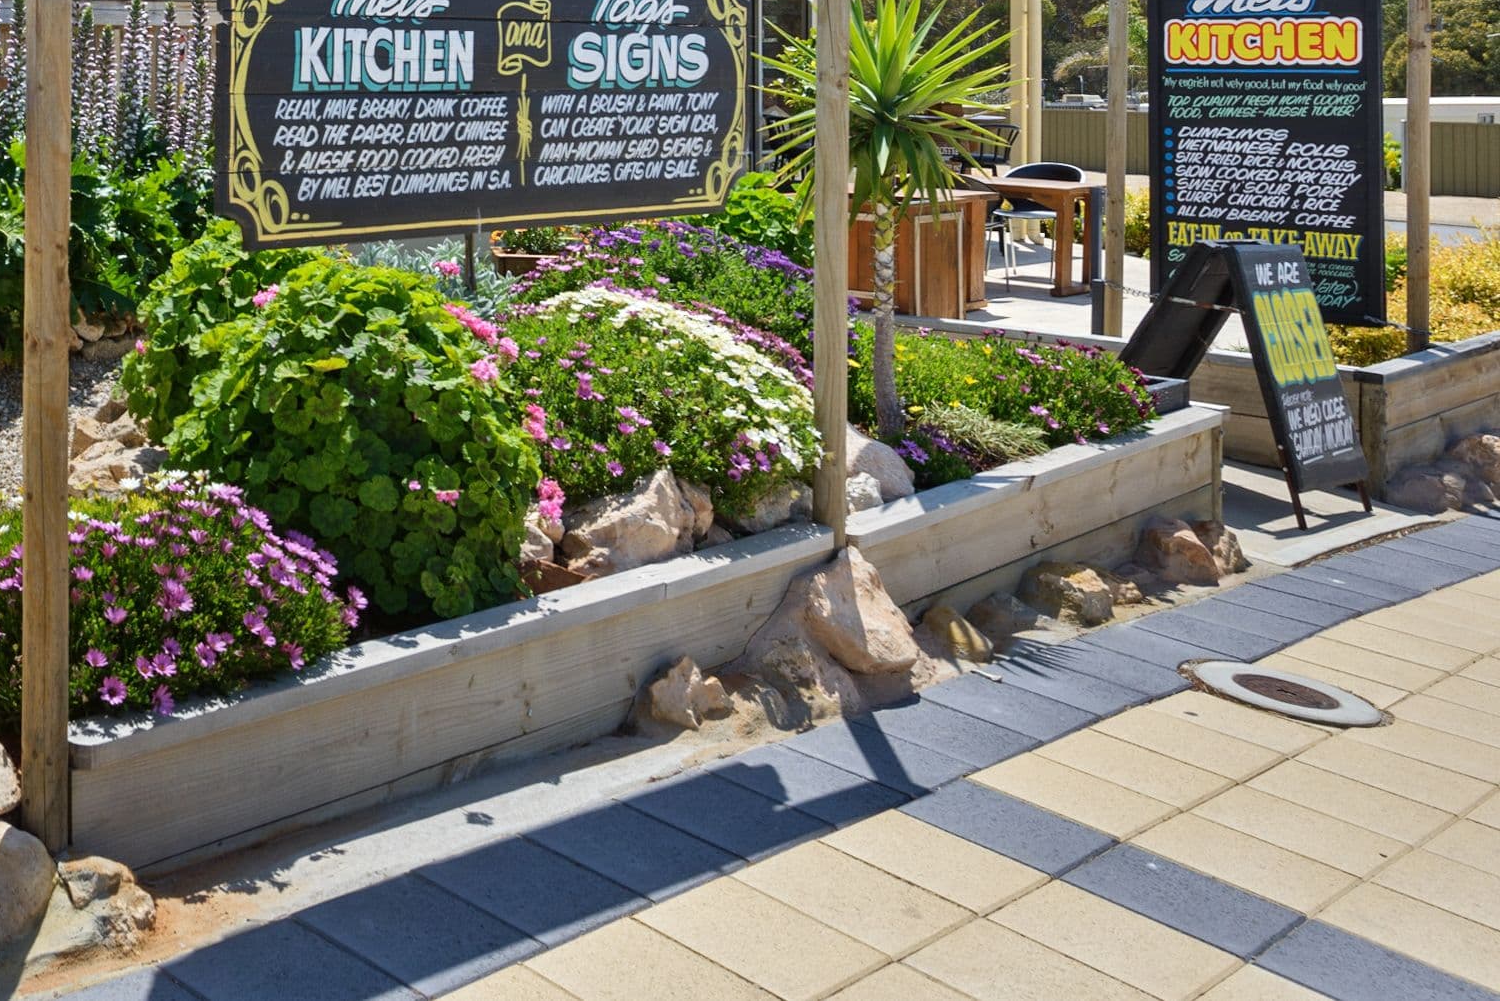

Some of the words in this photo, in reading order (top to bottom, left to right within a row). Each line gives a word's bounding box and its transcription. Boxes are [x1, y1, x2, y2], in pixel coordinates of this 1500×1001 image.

[505, 14, 546, 49] and
[1165, 18, 1362, 65] KITCHEN
[293, 27, 474, 91] KITCHEN
[567, 32, 709, 89] SIGNS
[1210, 77, 1224, 88] not
[1245, 79, 1270, 90] good,
[1271, 79, 1286, 89] but
[1288, 81, 1301, 91] my
[1303, 79, 1323, 90] food
[274, 98, 321, 121] RELAX,
[322, 98, 358, 120] HAVE
[358, 97, 412, 120] BREAKY,
[414, 98, 458, 118] DRINK
[459, 96, 508, 119] COFFEE,
[540, 94, 575, 114] WITH
[576, 95, 588, 114] A
[589, 94, 637, 114] BRUSH
[636, 92, 647, 112] &
[647, 93, 683, 113] PAINT,
[685, 92, 719, 111] TONY
[1167, 95, 1191, 107] TOP
[1192, 95, 1243, 107] QUALITY
[1242, 95, 1279, 106] FRESH
[1278, 95, 1314, 105] HOME
[1313, 94, 1360, 105] COOKED
[1169, 107, 1203, 119] FOOD,
[273, 125, 319, 147] READ
[321, 124, 350, 146] THE
[350, 123, 405, 145] PAPER,
[406, 122, 454, 143] ENJOY
[454, 120, 509, 141] CHINESE
[540, 118, 570, 138] CAN
[571, 116, 615, 137] CREATE
[657, 115, 690, 135] SIGN
[690, 114, 719, 134] IDEA,
[1177, 126, 1290, 141] DUMPLINGS
[280, 151, 296, 174] &
[296, 150, 356, 174] AUSSIE
[354, 148, 399, 172] FOOD
[399, 147, 459, 170] COOKED
[458, 145, 506, 167] FRESH
[625, 139, 660, 160] SHED
[660, 137, 703, 158] SIGNS
[703, 140, 712, 156] &
[1178, 138, 1284, 155] VIETNAMESE
[1285, 142, 1350, 158] ROLLS
[534, 162, 612, 186] CARICATURES,
[613, 160, 645, 181] GIFTS
[645, 160, 662, 178] ON
[663, 159, 700, 179] SALE.
[1174, 152, 1205, 164] STIR
[1204, 153, 1242, 166] FRIED
[1243, 155, 1276, 168] RICE
[1276, 159, 1285, 168] &
[1286, 158, 1358, 172] NOODLES
[298, 177, 321, 202] BY
[352, 174, 391, 198] BEST
[391, 171, 469, 197] DUMPLINGS
[470, 171, 487, 191] IN
[1175, 164, 1215, 179] SLOW
[1215, 166, 1279, 182] COOKED
[1279, 170, 1319, 185] PORK
[1318, 172, 1362, 188] BELLY
[1176, 178, 1230, 192] SWEET
[1242, 182, 1292, 196] SOUR
[1294, 184, 1349, 198] PORK
[1176, 190, 1225, 204] CURRY
[1227, 193, 1291, 209] CHICKEN
[1290, 201, 1300, 210] &
[1302, 198, 1341, 212] RICE
[1177, 206, 1202, 218] ALL
[1199, 207, 1228, 219] DAY
[1225, 209, 1289, 225] BREAKY,
[1294, 213, 1357, 228] COFFEE
[1255, 262, 1274, 286] WE
[1277, 261, 1301, 284] ARE
[1287, 406, 1303, 431] WE
